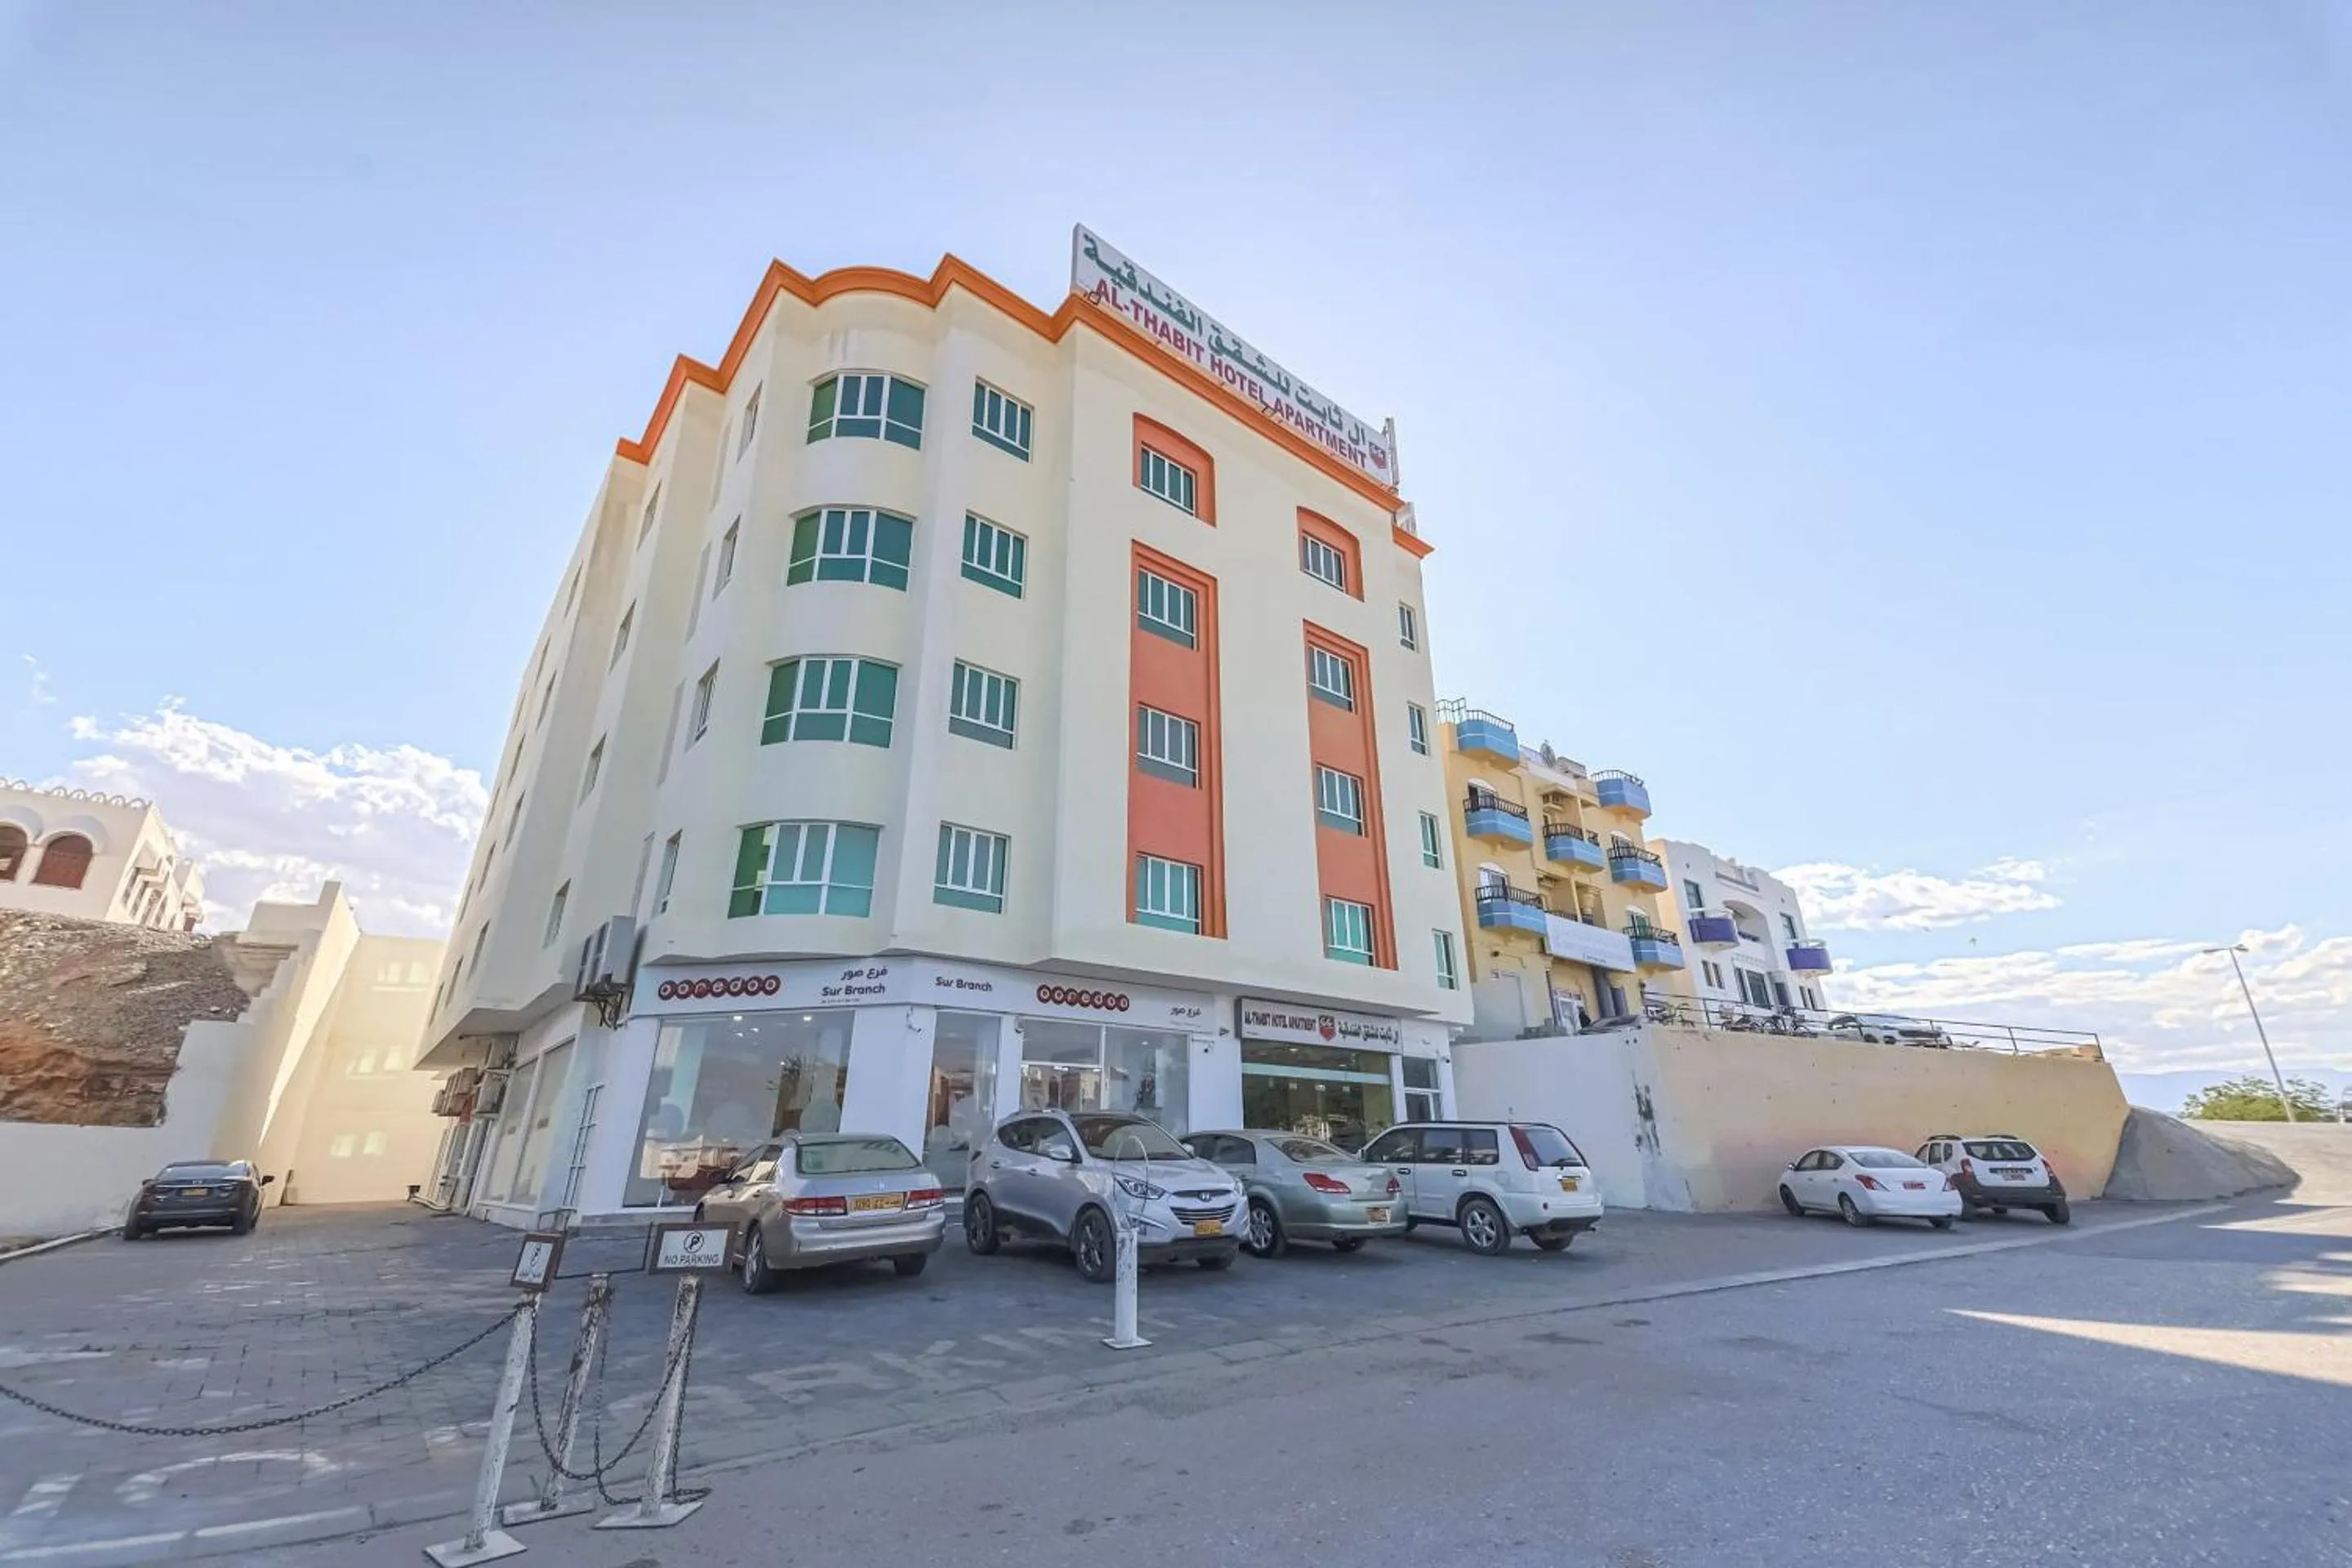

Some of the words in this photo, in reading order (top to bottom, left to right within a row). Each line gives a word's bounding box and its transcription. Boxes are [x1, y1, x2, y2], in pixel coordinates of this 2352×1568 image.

[1083, 233, 1204, 338] الفندقية
[1095, 278, 1205, 363] AL-THABIT
[1209, 354, 1267, 406] HOTEL
[1273, 396, 1367, 468] APARTMENT
[1207, 323, 1291, 397] للشقق
[658, 974, 782, 1000] ooredoo
[822, 986, 843, 996] Sur
[844, 982, 885, 995] Branch
[935, 976, 954, 987] Sur
[956, 978, 992, 991] Branch
[1036, 984, 1130, 1013] ooredoo
[665, 1254, 678, 1265] NO
[679, 1254, 719, 1264] PARKING
